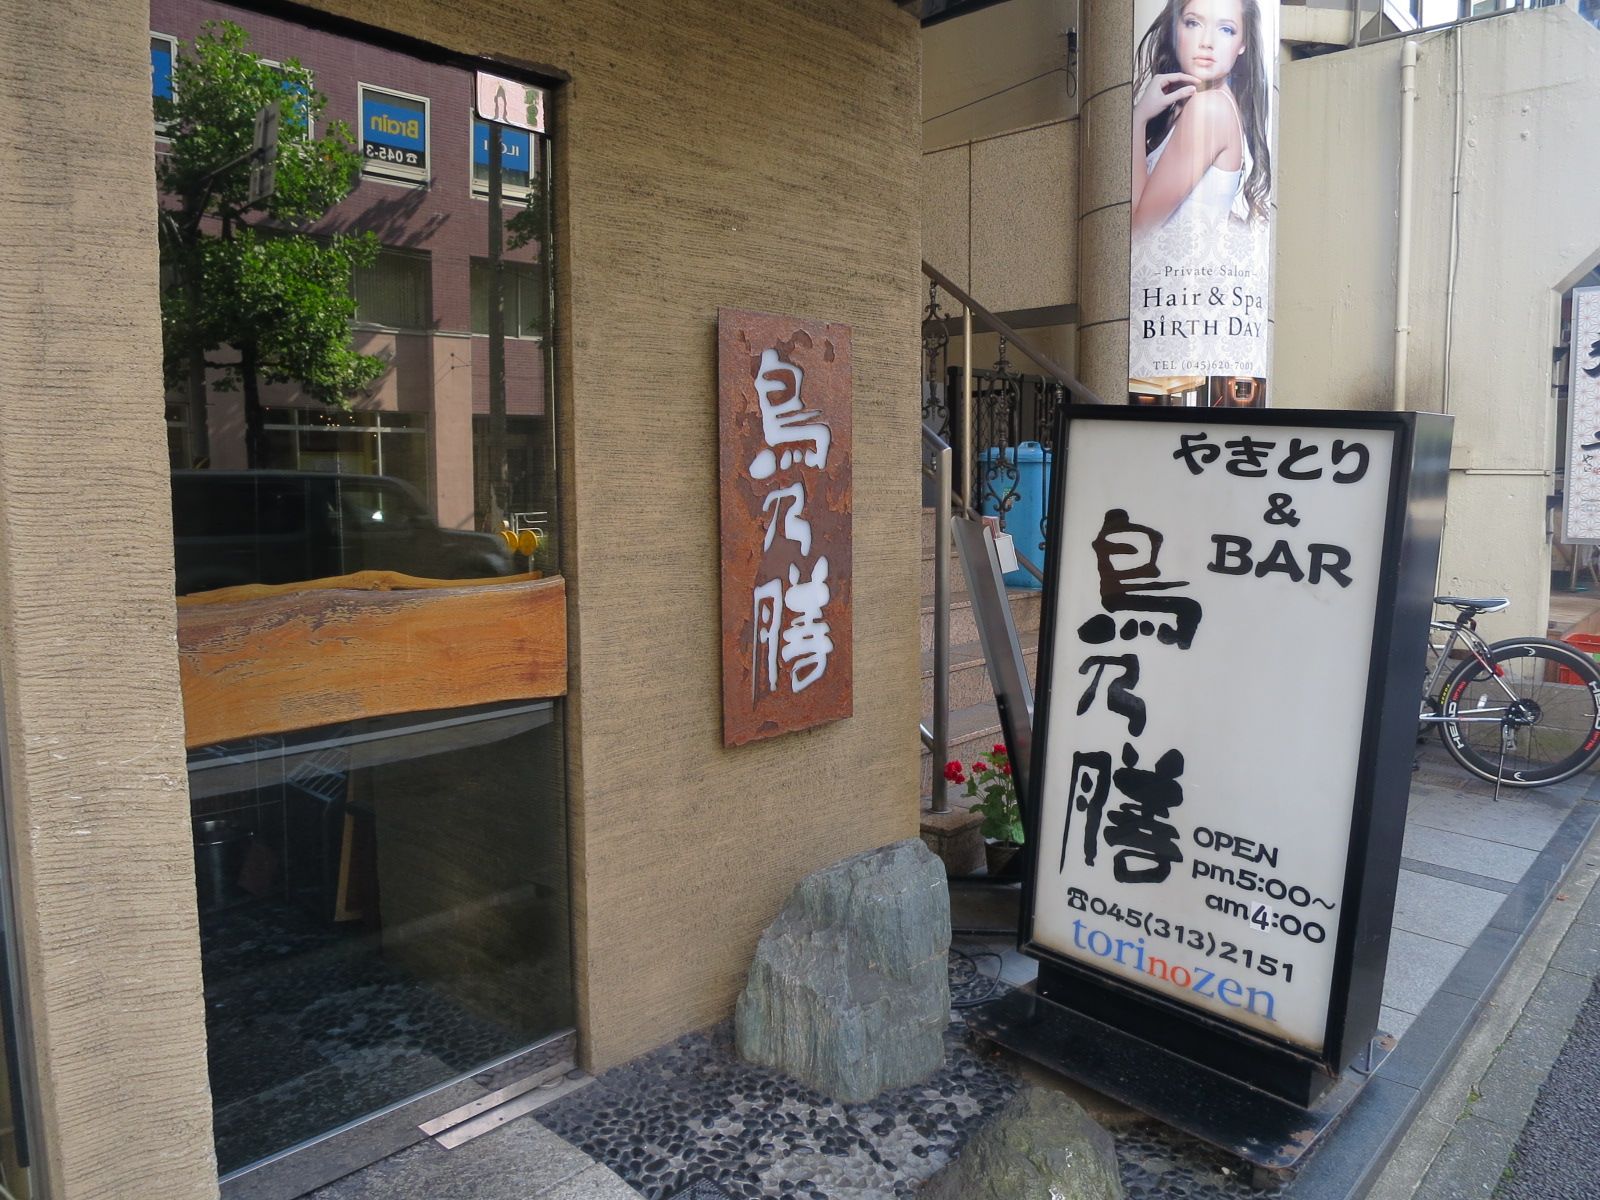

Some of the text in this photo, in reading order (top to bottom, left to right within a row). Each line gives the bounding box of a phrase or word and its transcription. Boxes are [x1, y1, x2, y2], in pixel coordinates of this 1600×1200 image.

[1142, 286, 1263, 316] Hair & Spa
[1153, 361, 1177, 371] TEL
[1172, 431, 1371, 484] やきとり
[1263, 492, 1301, 528] &
[1206, 533, 1353, 589] BAR
[1192, 826, 1279, 868] OPEN
[1204, 893, 1326, 944] am4:00
[1072, 918, 1278, 1023] torinozen
